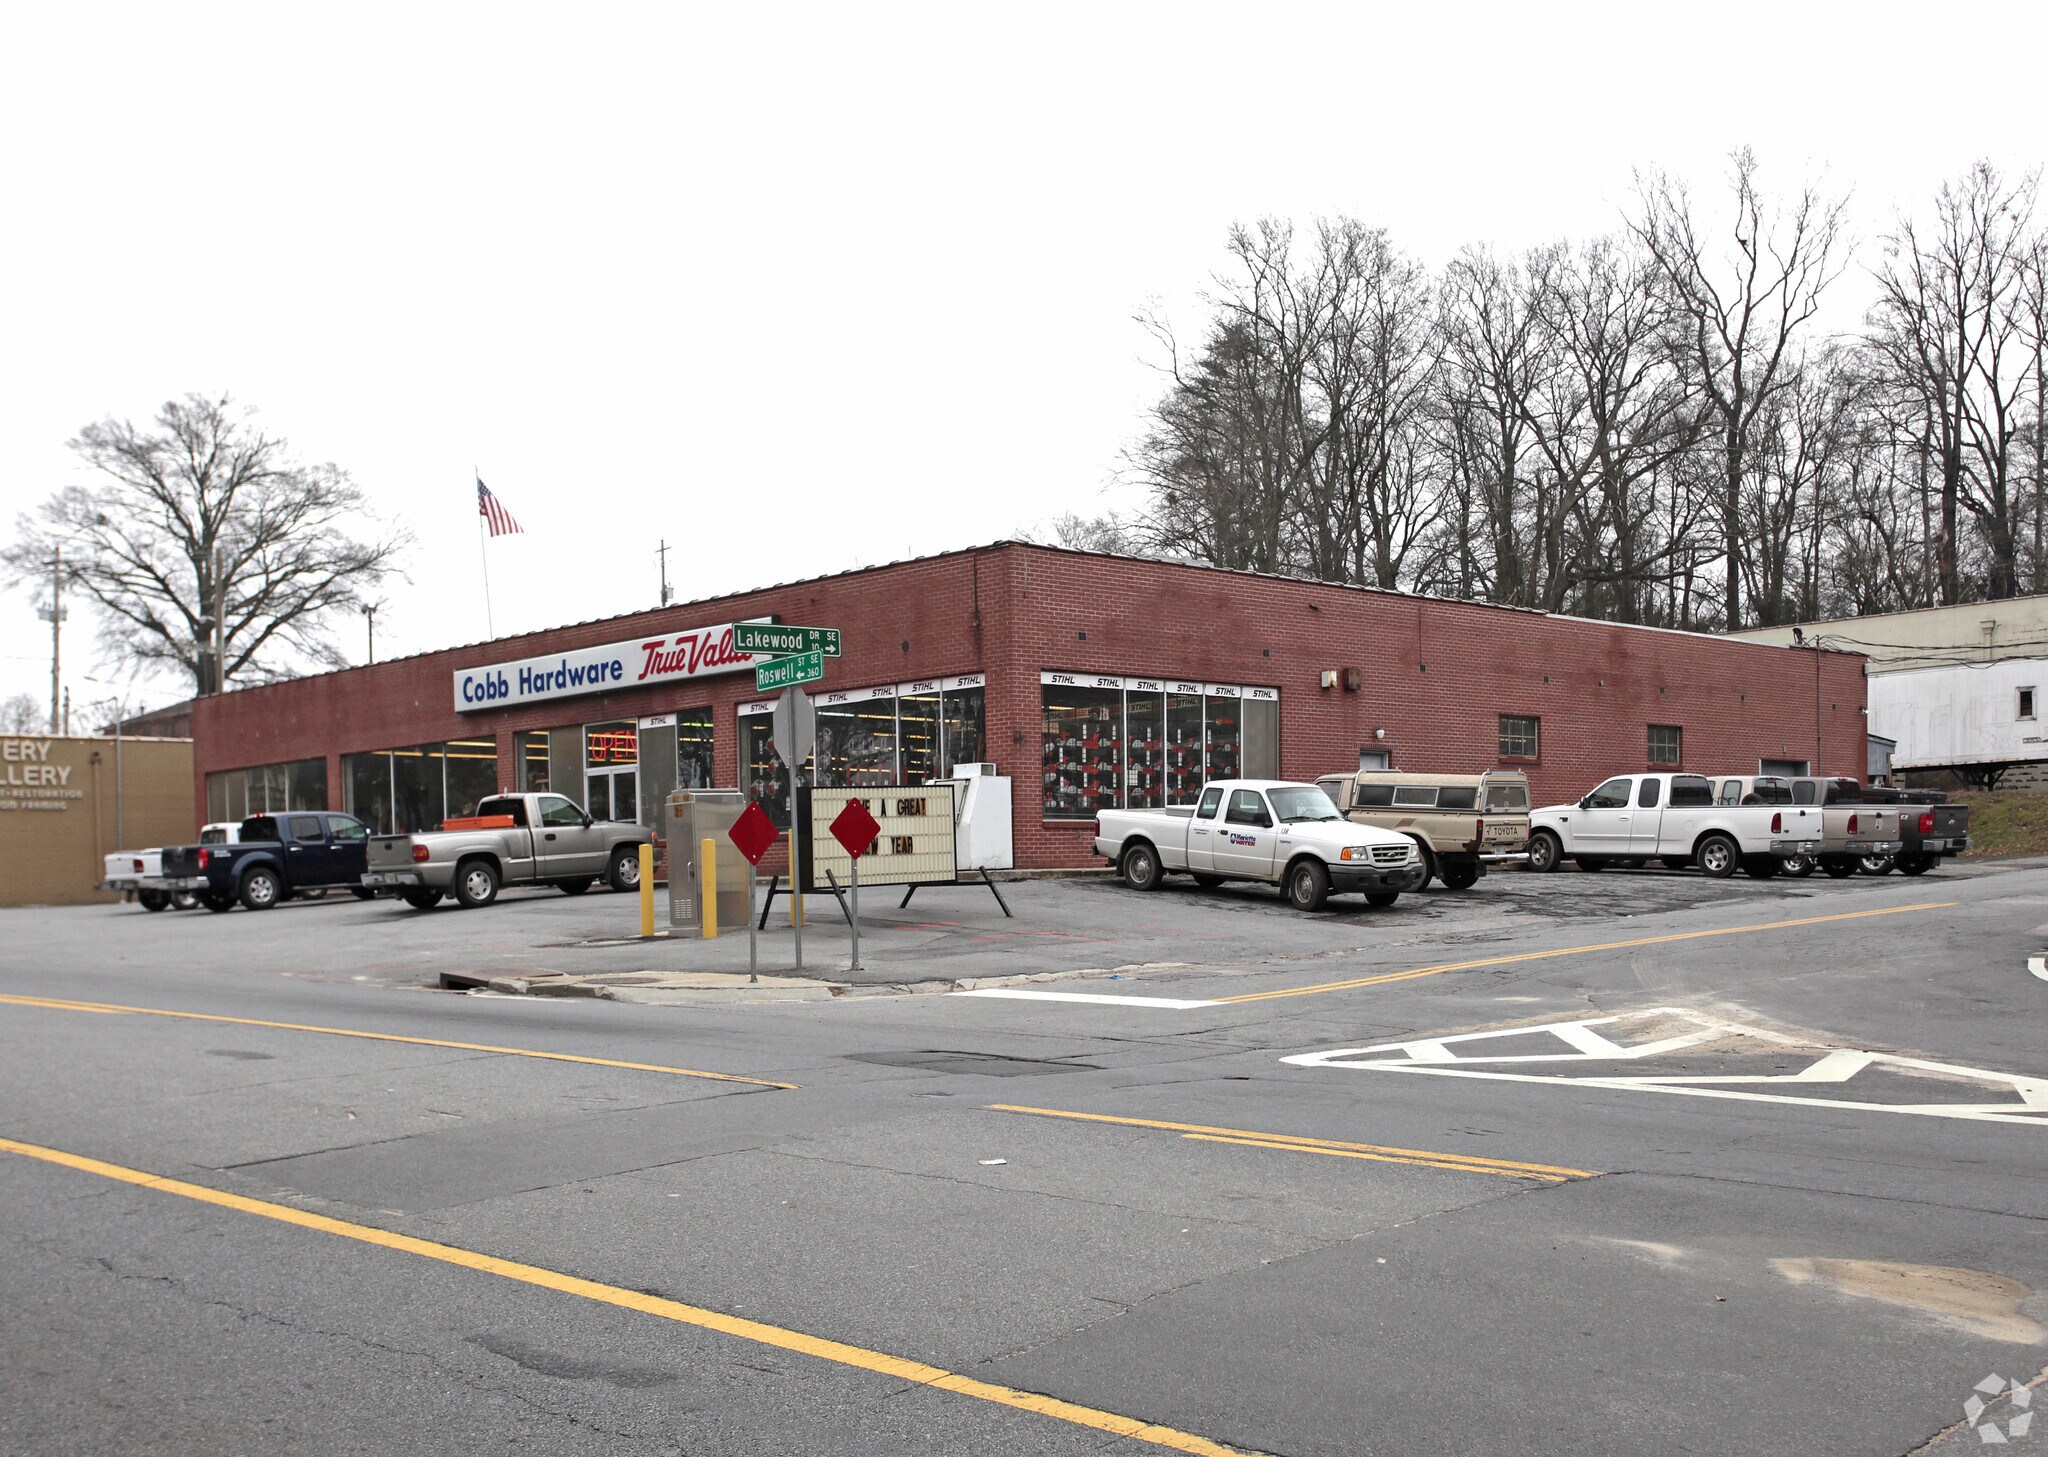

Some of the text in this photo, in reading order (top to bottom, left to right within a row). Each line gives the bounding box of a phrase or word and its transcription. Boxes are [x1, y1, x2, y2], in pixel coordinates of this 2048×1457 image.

[737, 629, 836, 649] Lakewood DR SE
[798, 654, 818, 666] ST SE
[759, 662, 819, 685] Roswell 360
[463, 659, 623, 702] Cobb Hardware
[957, 675, 981, 687] STIHL
[1051, 674, 1075, 685] STIHL
[1097, 678, 1120, 688] STIHL
[912, 682, 934, 693] STIHL
[1137, 681, 1159, 690] STIHL
[1177, 684, 1198, 693] STIHL
[872, 687, 893, 698] STIHL
[1215, 687, 1236, 696] STIHL
[1253, 690, 1273, 699] STIHL
[828, 693, 848, 703] STIHL
[750, 704, 769, 712] STIHL
[650, 717, 667, 726] STIHL
[591, 730, 638, 760] OPEN
[881, 798, 887, 817] A
[1494, 827, 1518, 836] TOYOTA
[891, 836, 913, 854] YEAR
